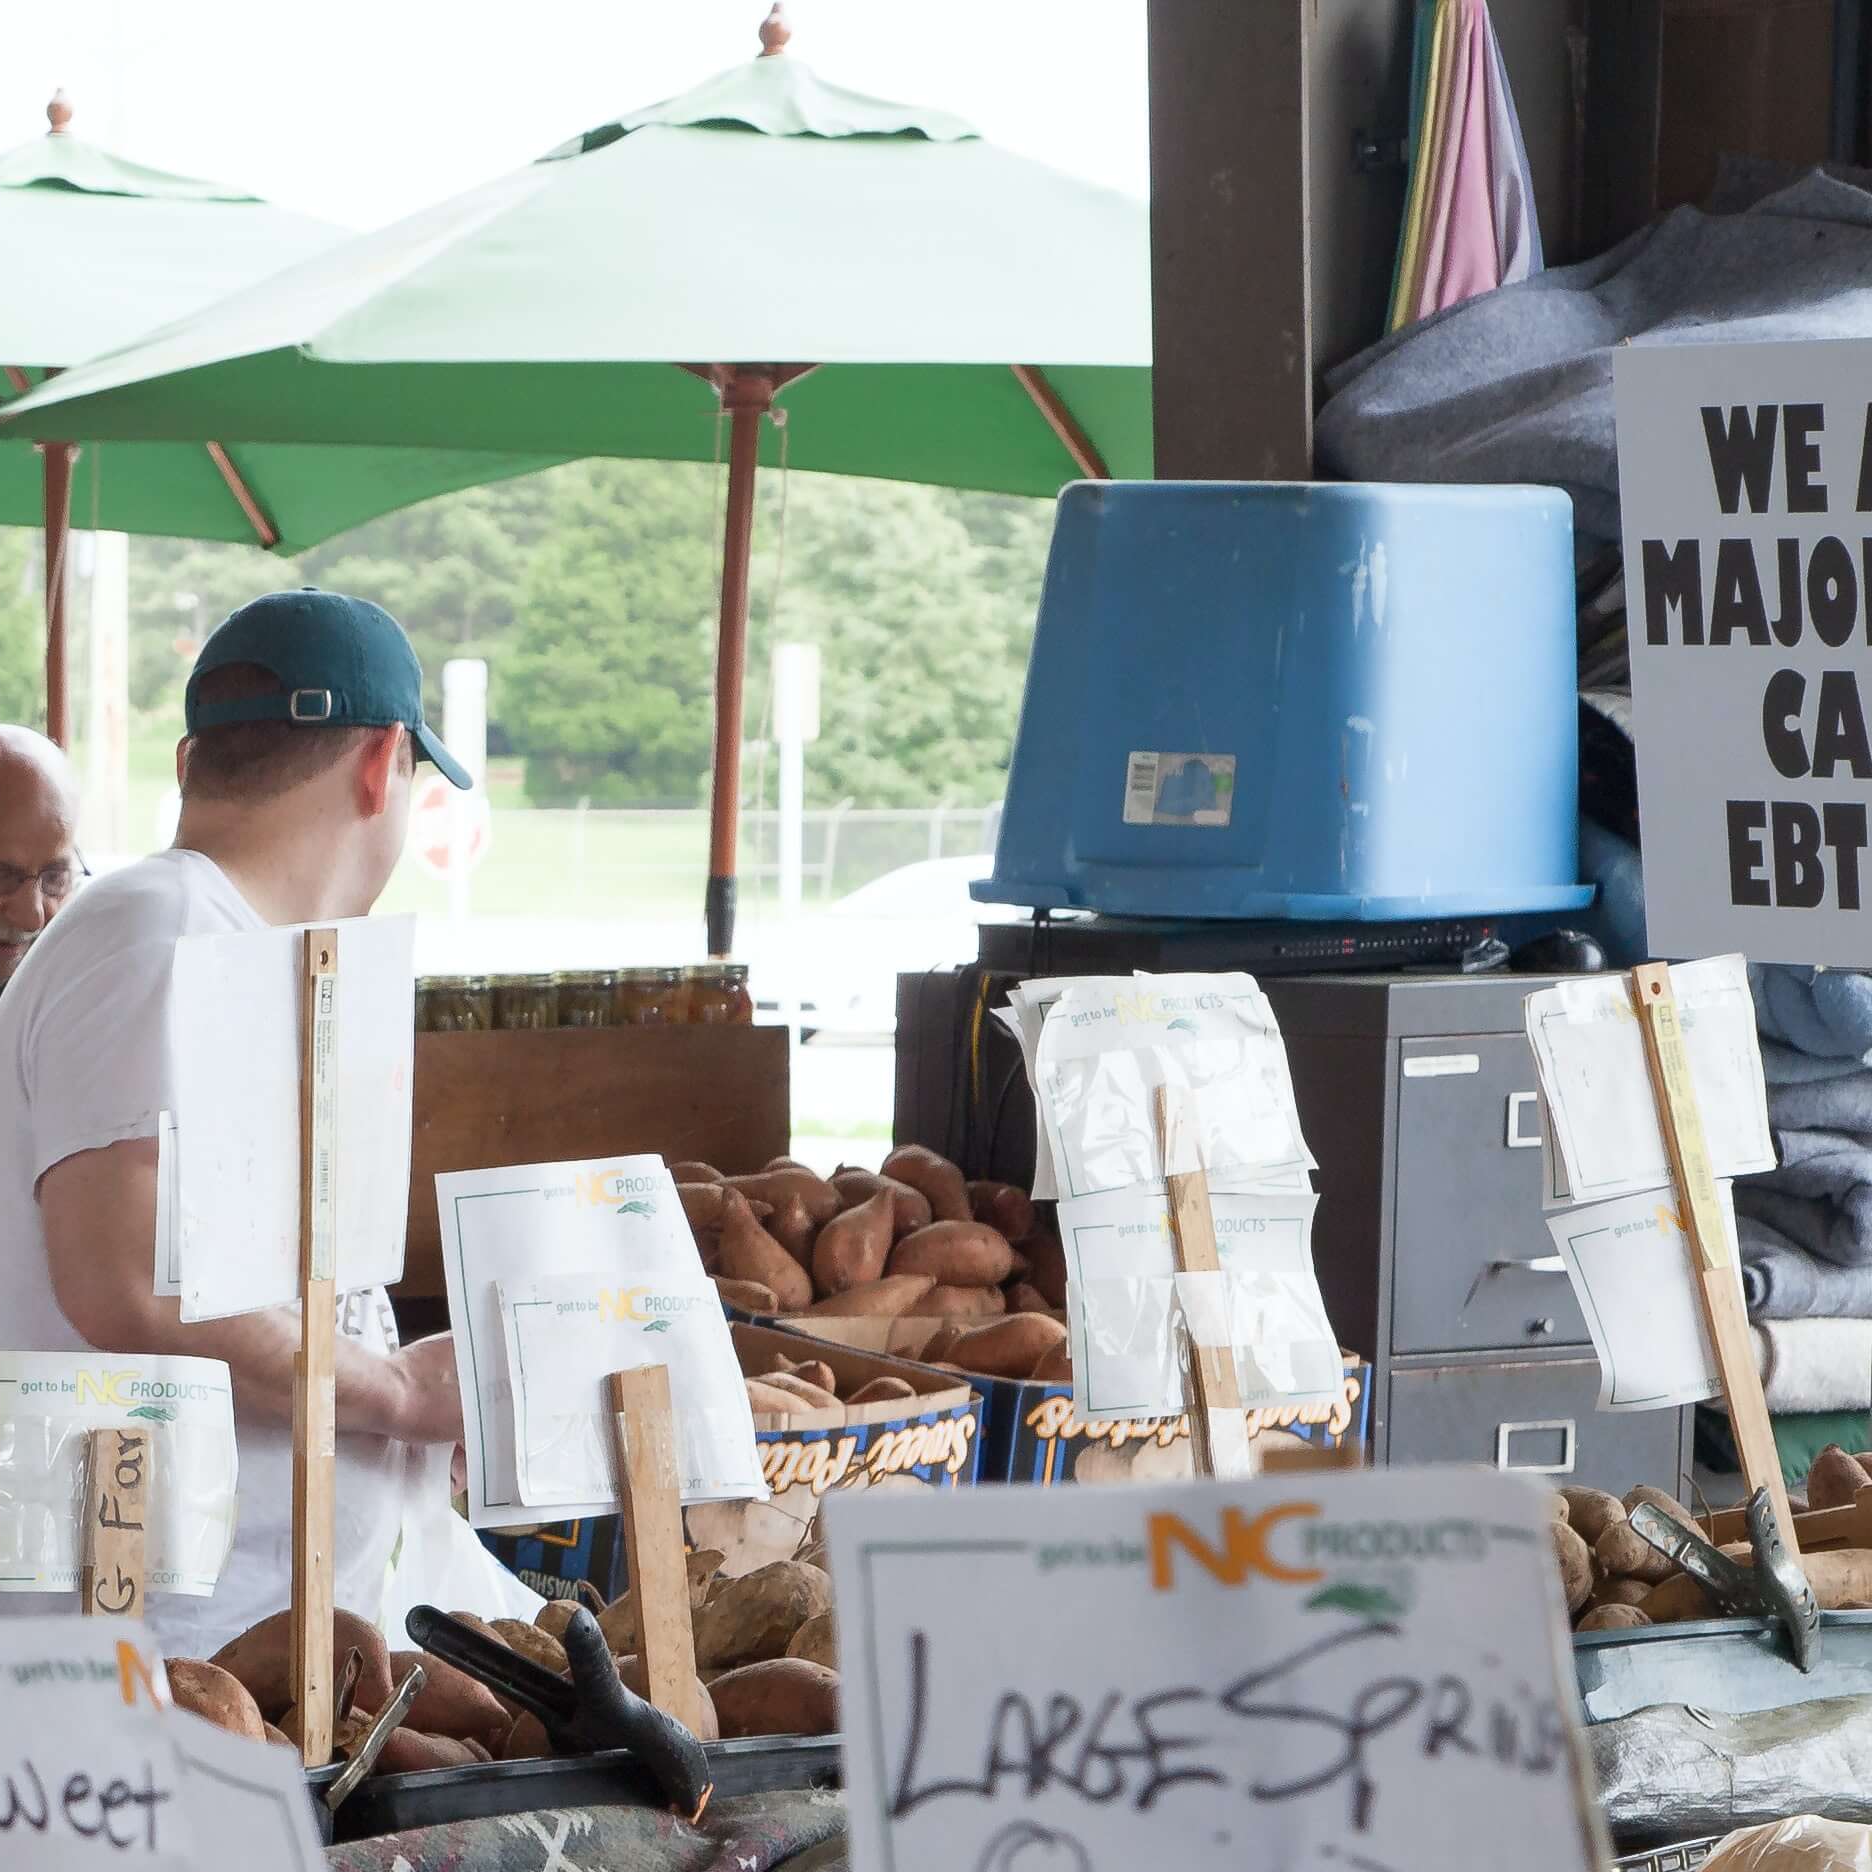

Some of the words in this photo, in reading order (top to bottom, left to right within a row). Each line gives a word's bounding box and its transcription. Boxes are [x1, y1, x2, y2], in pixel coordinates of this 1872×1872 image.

[1700, 403, 1829, 515] WE
[1726, 800, 1870, 911] EBT
[1070, 1011, 1090, 1027] got
[1090, 1009, 1103, 1021] to
[1105, 1006, 1117, 1019] be
[1213, 1218, 1267, 1235] ODUCTS
[1613, 1223, 1632, 1239] got
[1632, 1221, 1644, 1235] to
[1644, 1218, 1659, 1234] be
[555, 1301, 576, 1316] got
[577, 1300, 588, 1312] to
[588, 1299, 600, 1312] be
[20, 1379, 44, 1396] got
[45, 1379, 59, 1394] to
[60, 1378, 77, 1394] be
[74, 1368, 144, 1407] NC
[129, 1381, 209, 1401] PRODUCTS
[1145, 1501, 1325, 1590] NC
[1302, 1516, 1490, 1565] PRODUCTS
[888, 1629, 1227, 1821] LARGE
